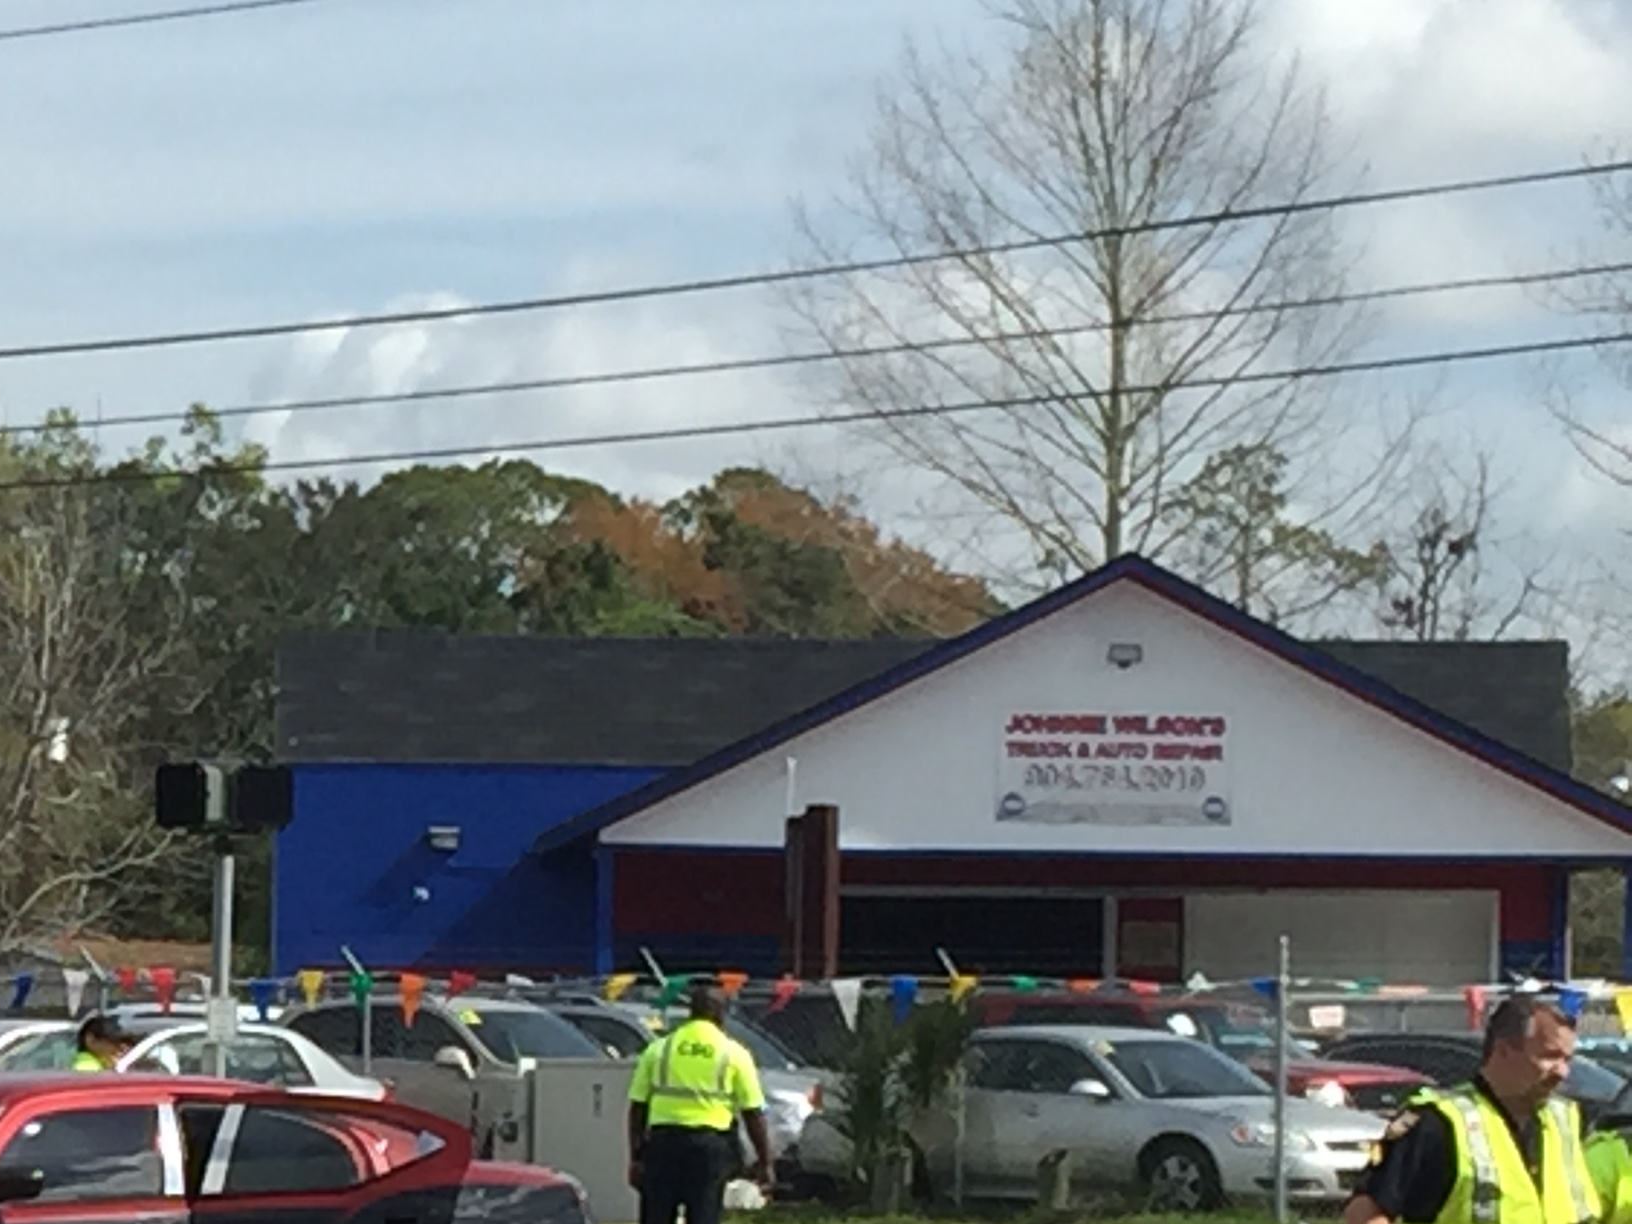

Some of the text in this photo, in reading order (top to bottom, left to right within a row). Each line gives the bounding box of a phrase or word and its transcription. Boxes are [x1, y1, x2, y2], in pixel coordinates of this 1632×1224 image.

[1005, 741, 1223, 761] TRUCK & AUTO REPAIR
